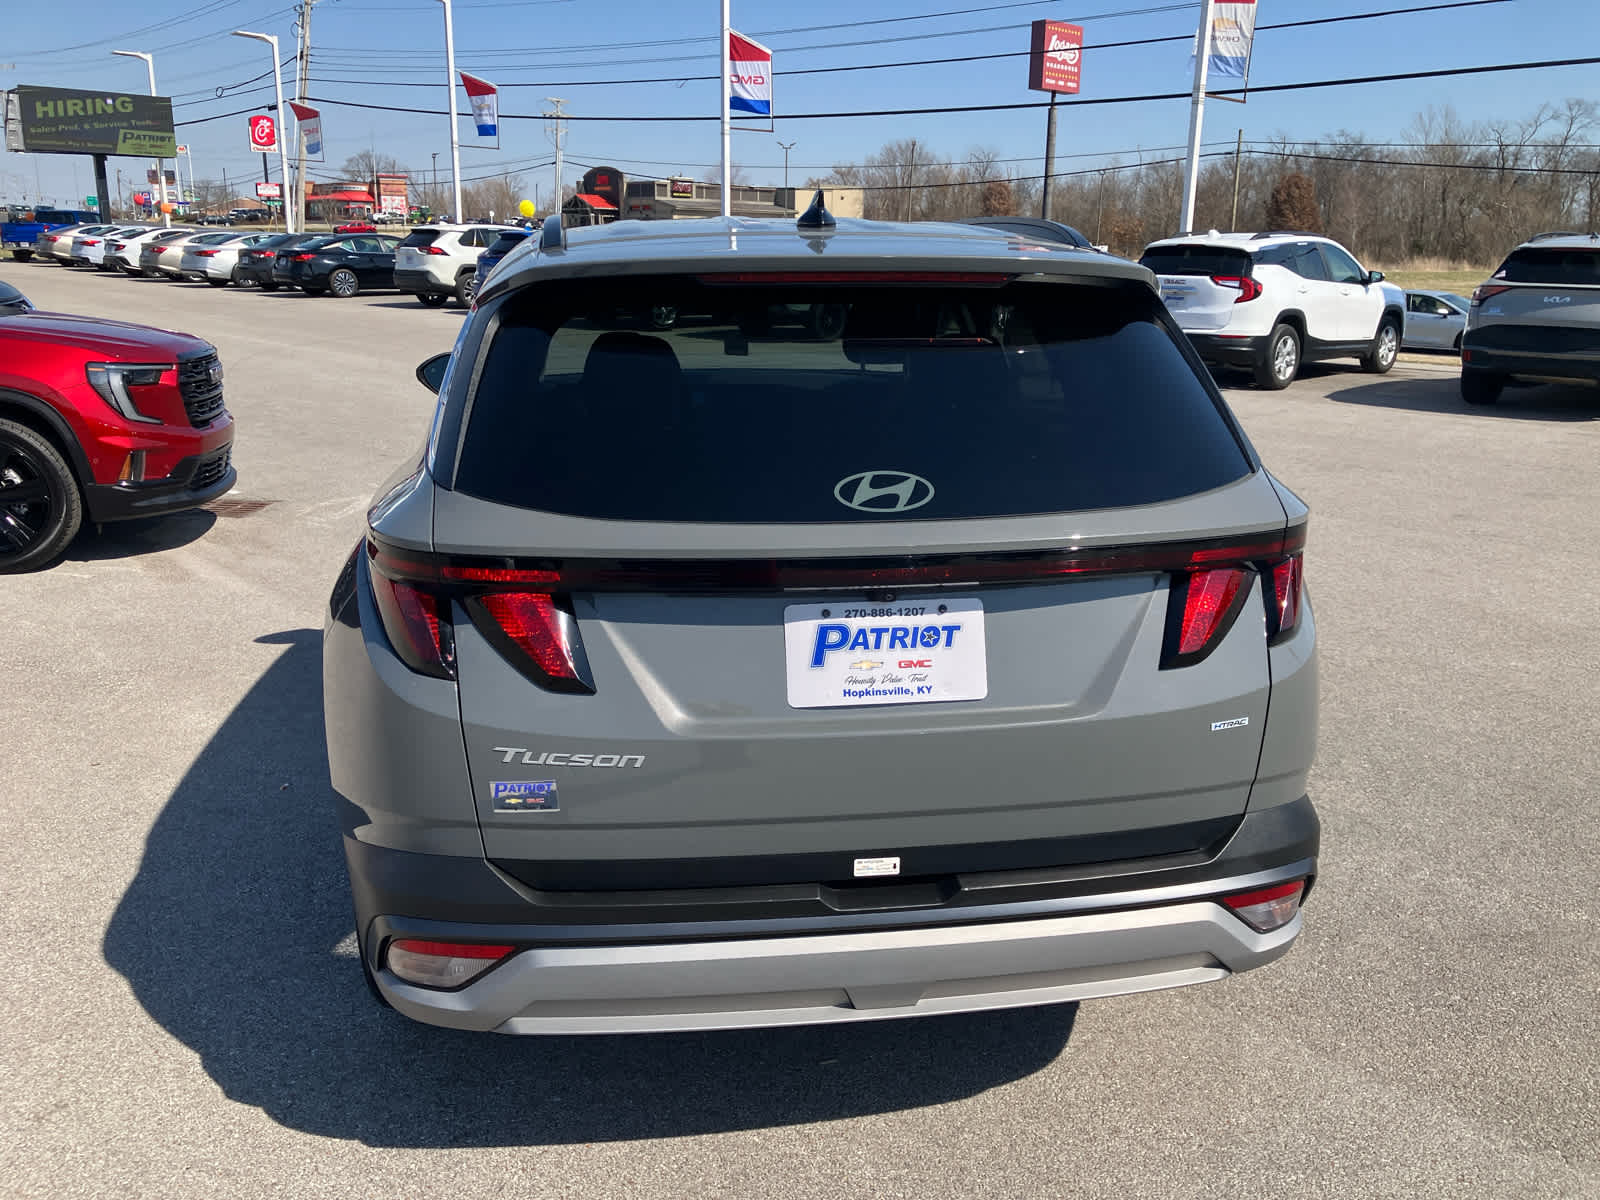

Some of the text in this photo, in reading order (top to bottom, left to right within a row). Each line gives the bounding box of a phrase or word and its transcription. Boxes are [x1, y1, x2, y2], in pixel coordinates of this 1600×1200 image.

[35, 96, 134, 118] HIRING
[30, 126, 57, 134] Sales
[122, 131, 173, 143] PATRIOT
[844, 607, 926, 618] 270-886-1207
[810, 623, 961, 668] PATRIOT
[898, 659, 932, 668] GMC
[843, 685, 933, 698] Hopkinsville, KY
[1214, 719, 1247, 729] HTRAC
[494, 782, 553, 798] PATRIOT
